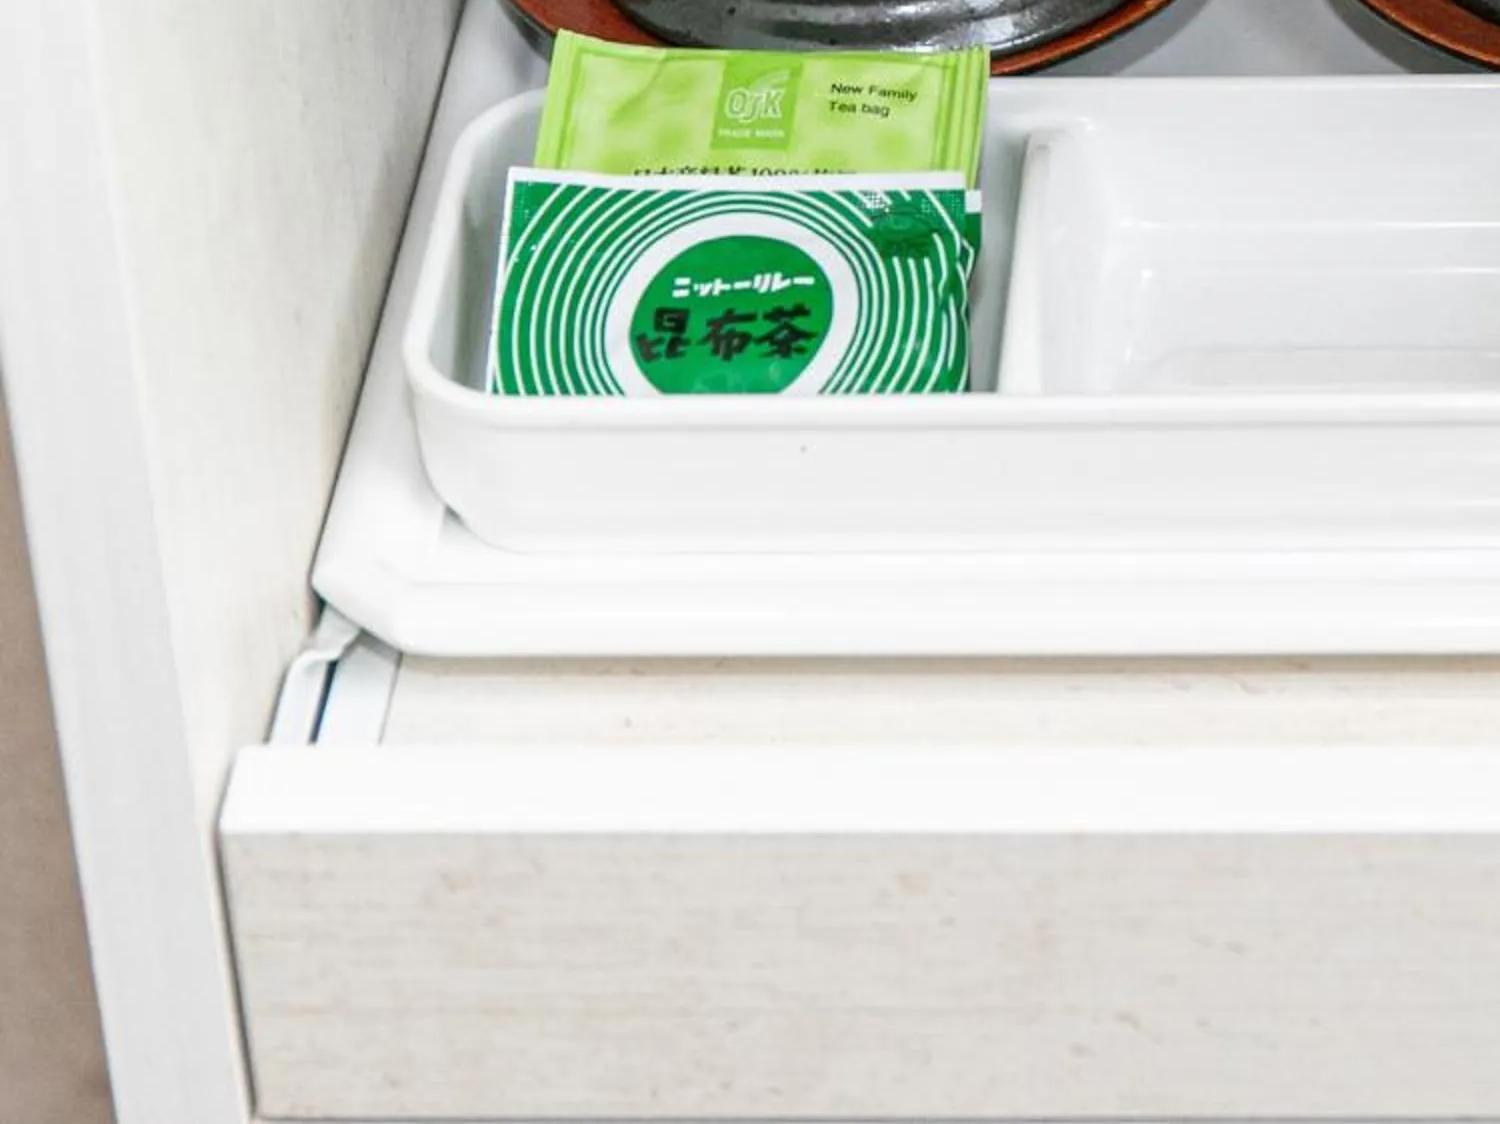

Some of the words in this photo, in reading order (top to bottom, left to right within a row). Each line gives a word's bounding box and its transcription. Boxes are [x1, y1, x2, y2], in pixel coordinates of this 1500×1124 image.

[831, 83, 863, 95] New
[868, 85, 918, 102] Family
[829, 100, 857, 113] Tea
[861, 102, 891, 117] bag
[672, 273, 815, 298] ニットーリレー
[636, 303, 818, 364] 昆布茶
